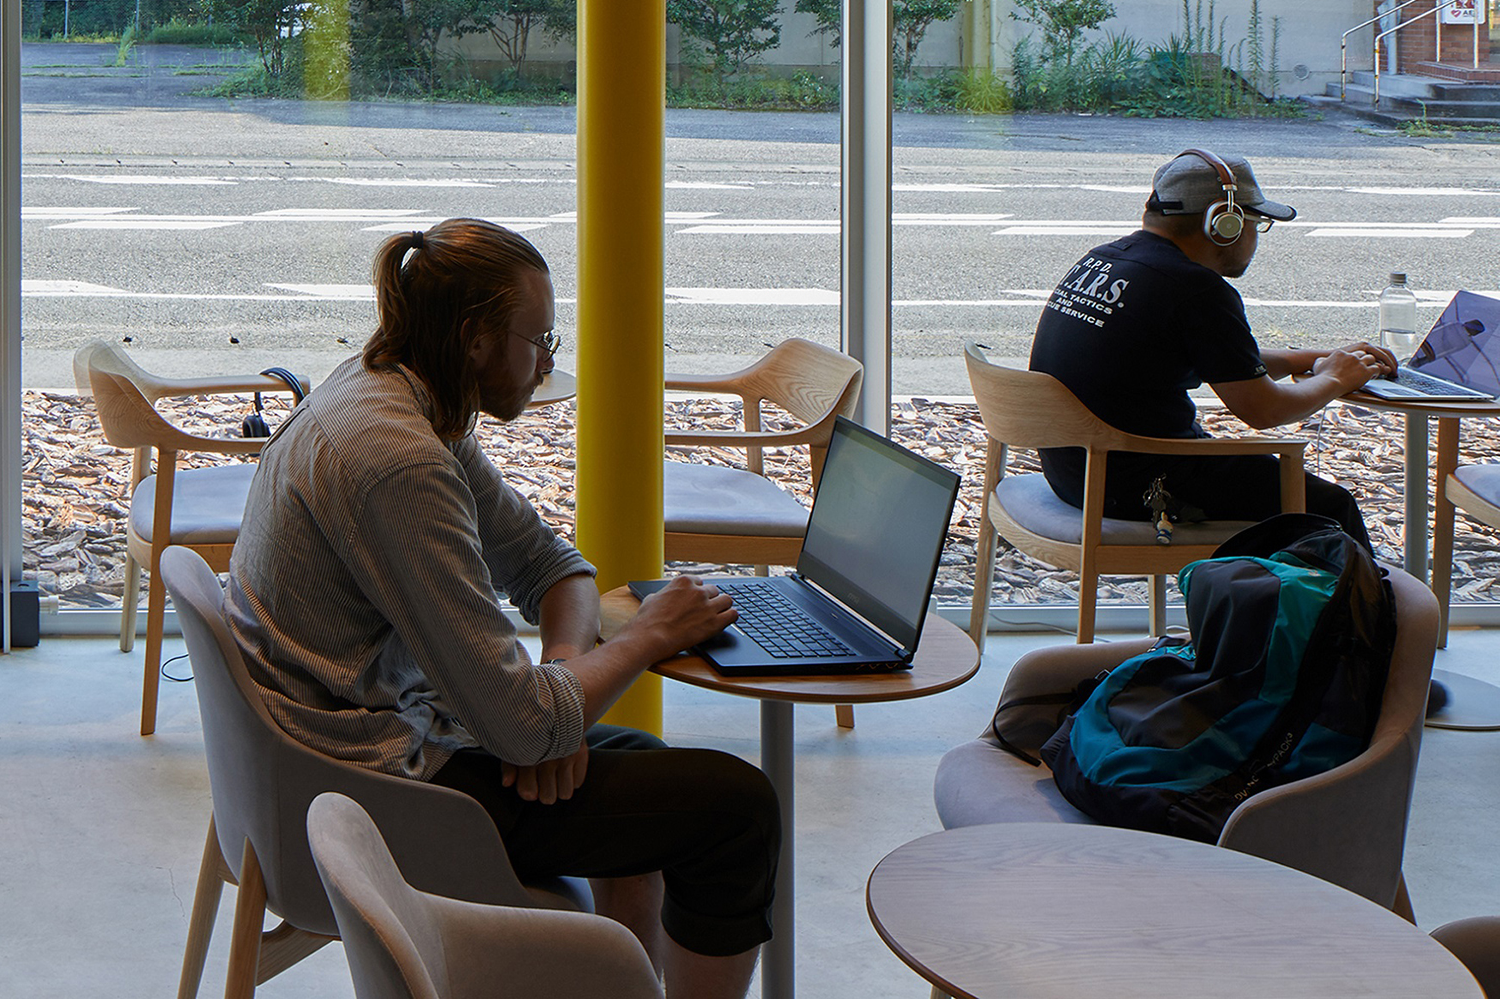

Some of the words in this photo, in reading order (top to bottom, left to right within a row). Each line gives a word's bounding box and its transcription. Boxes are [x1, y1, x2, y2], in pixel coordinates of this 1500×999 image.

[1083, 257, 1113, 273] R.P.D.
[1056, 297, 1073, 308] AND
[1070, 294, 1113, 315] TACTICS
[1060, 306, 1105, 328] SERVICE
